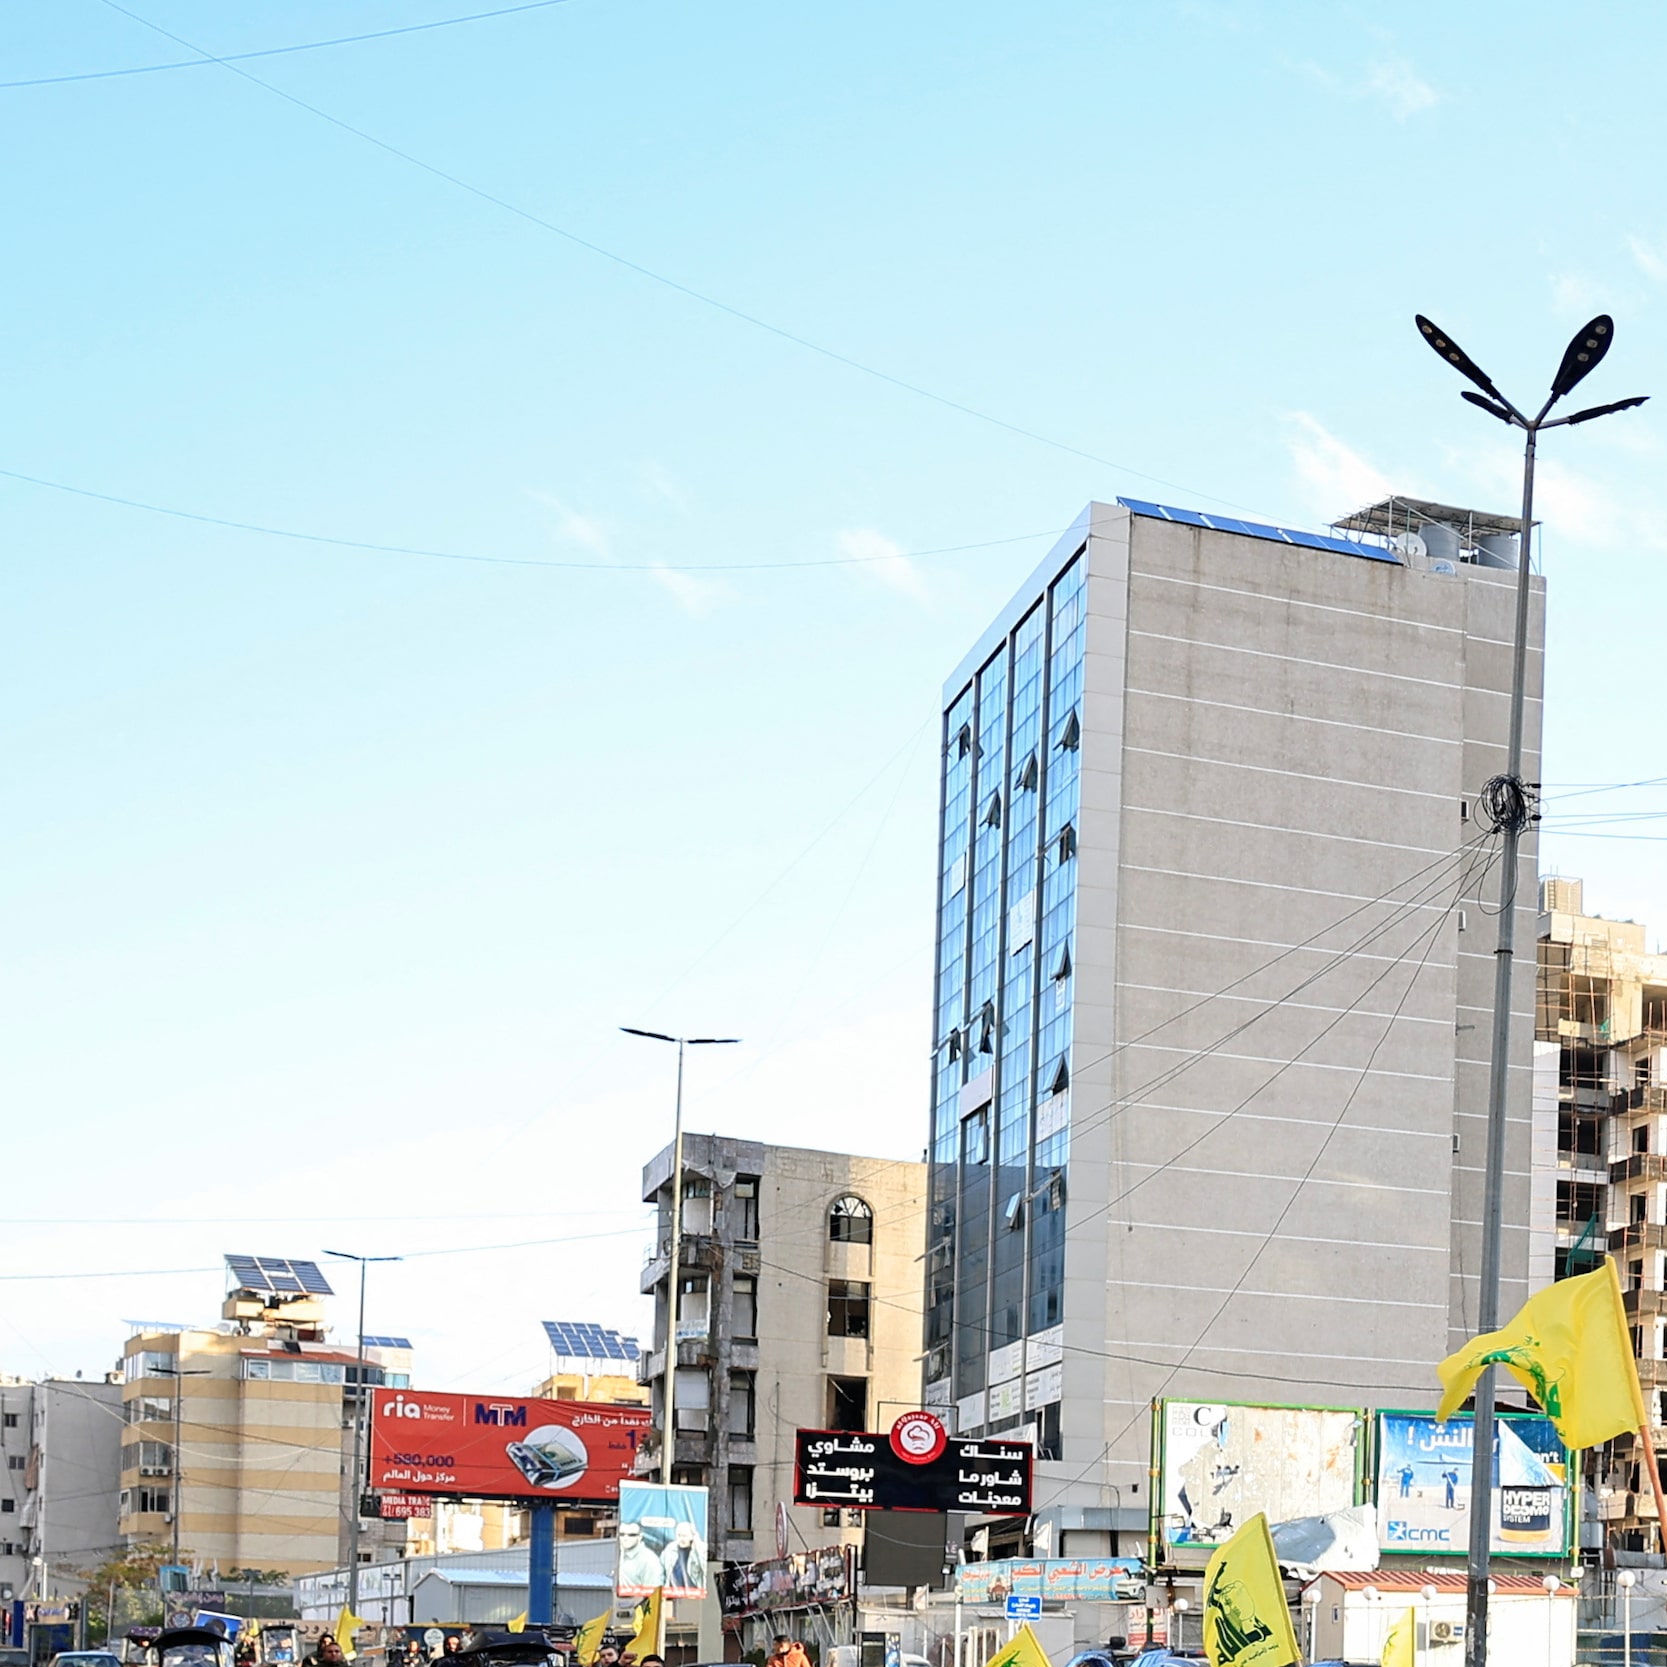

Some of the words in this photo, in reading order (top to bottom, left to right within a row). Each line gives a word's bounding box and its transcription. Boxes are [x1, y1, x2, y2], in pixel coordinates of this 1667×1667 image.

[383, 1394, 421, 1419] ria
[475, 1402, 527, 1427] MTM
[423, 1404, 451, 1415] Money
[423, 1412, 455, 1422] Transfer
[807, 1437, 875, 1458] مشاوي
[959, 1444, 1023, 1461] سناك
[383, 1469, 411, 1482] العالم
[412, 1471, 433, 1483] حول
[434, 1472, 456, 1484] مركز
[806, 1462, 875, 1482] بروستد
[959, 1469, 1022, 1487] شاورما
[806, 1482, 874, 1503] بيتزا
[958, 1491, 1022, 1509] معجنات
[1503, 1490, 1550, 1506] HYPER
[1503, 1515, 1531, 1524] SYSTEM
[1408, 1528, 1450, 1541] cmc
